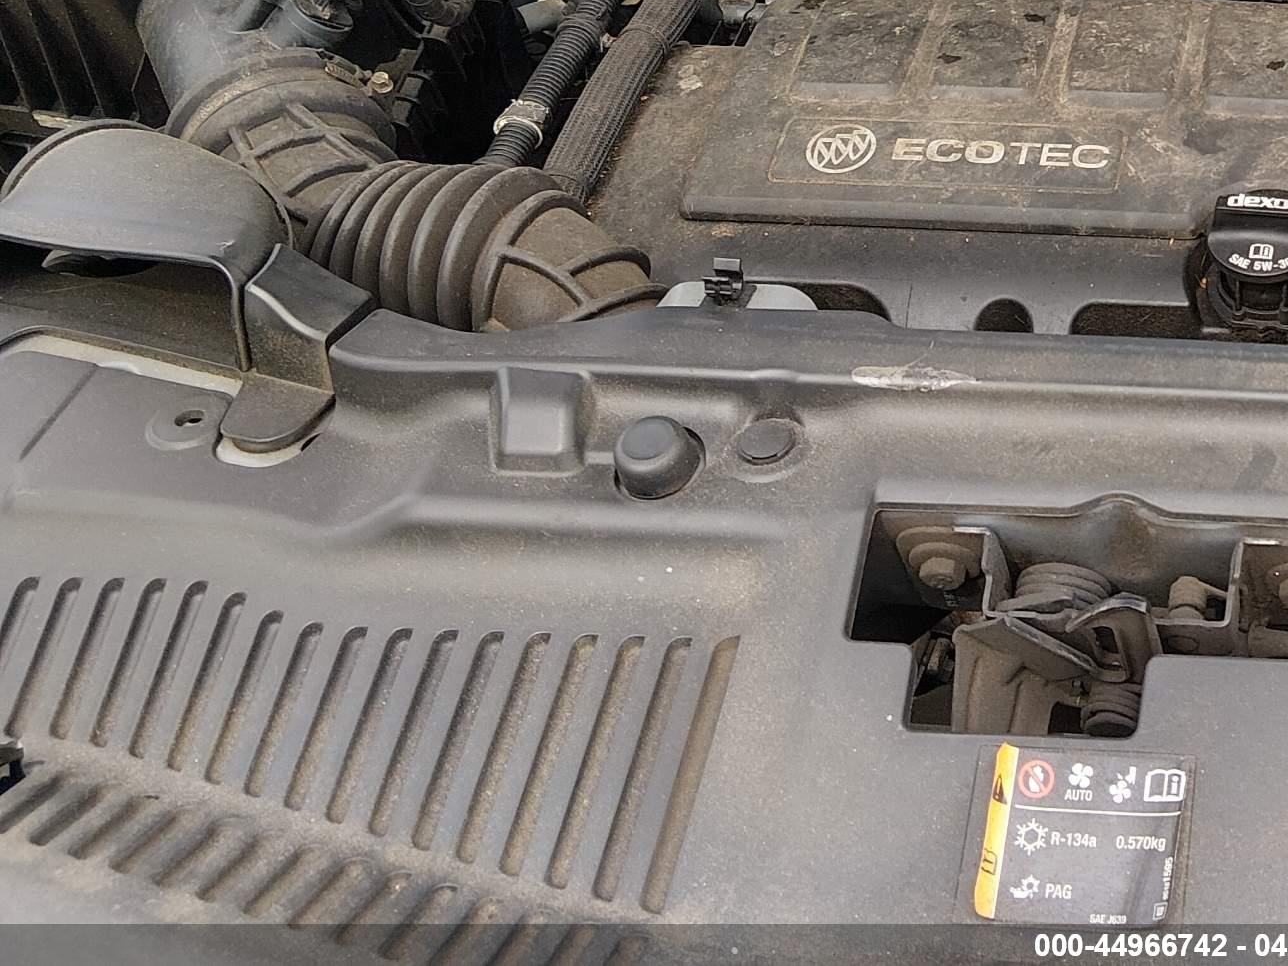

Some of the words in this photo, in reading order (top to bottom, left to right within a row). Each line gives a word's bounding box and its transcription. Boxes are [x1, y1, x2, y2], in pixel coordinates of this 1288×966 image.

[891, 137, 1111, 170] ECOTEC
[1228, 253, 1252, 270] SAE
[1064, 788, 1093, 802] AUTO
[1050, 831, 1097, 848] R-134a
[1116, 835, 1167, 852] 0.570kg
[1045, 883, 1073, 900] PAG
[1089, 913, 1106, 924] SAE
